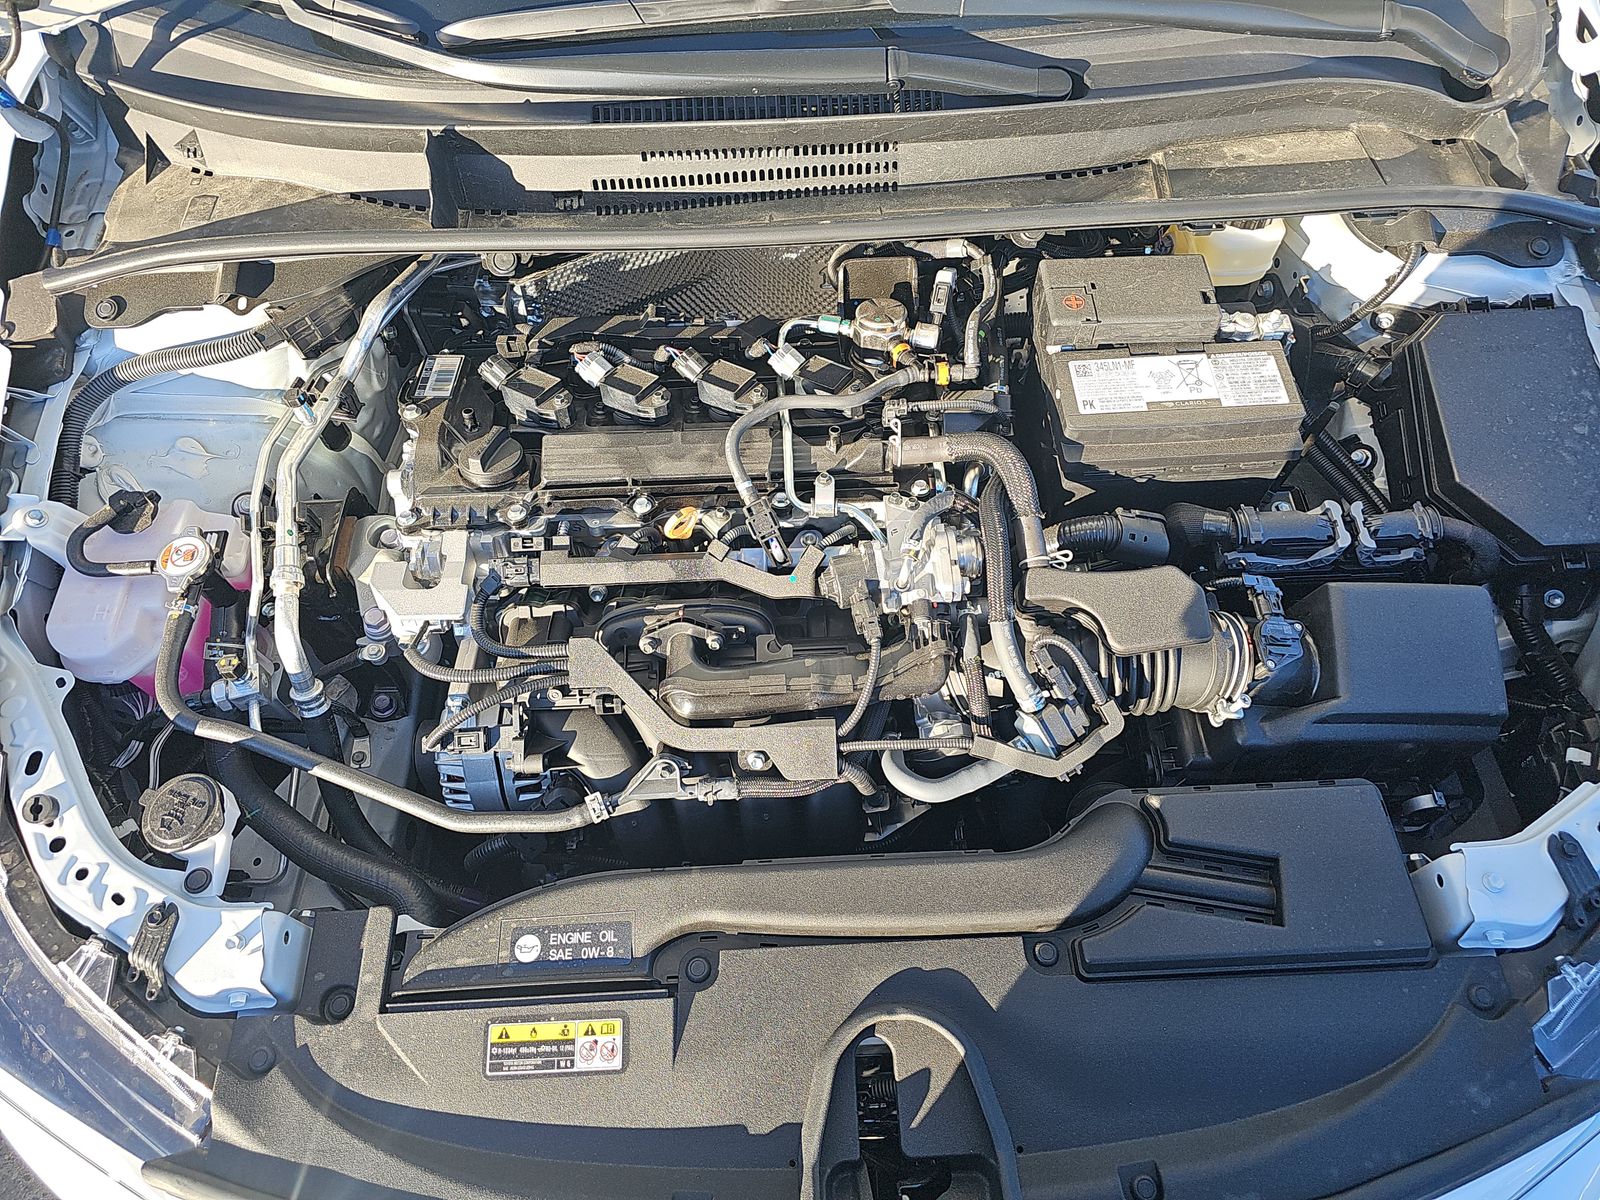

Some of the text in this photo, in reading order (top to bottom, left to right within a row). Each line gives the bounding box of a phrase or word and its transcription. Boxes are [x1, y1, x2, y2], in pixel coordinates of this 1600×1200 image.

[1189, 386, 1203, 394] Pb
[1082, 399, 1096, 410] PK
[548, 930, 618, 945] ENGINE OIL
[548, 946, 614, 961] SAE 0W-8
